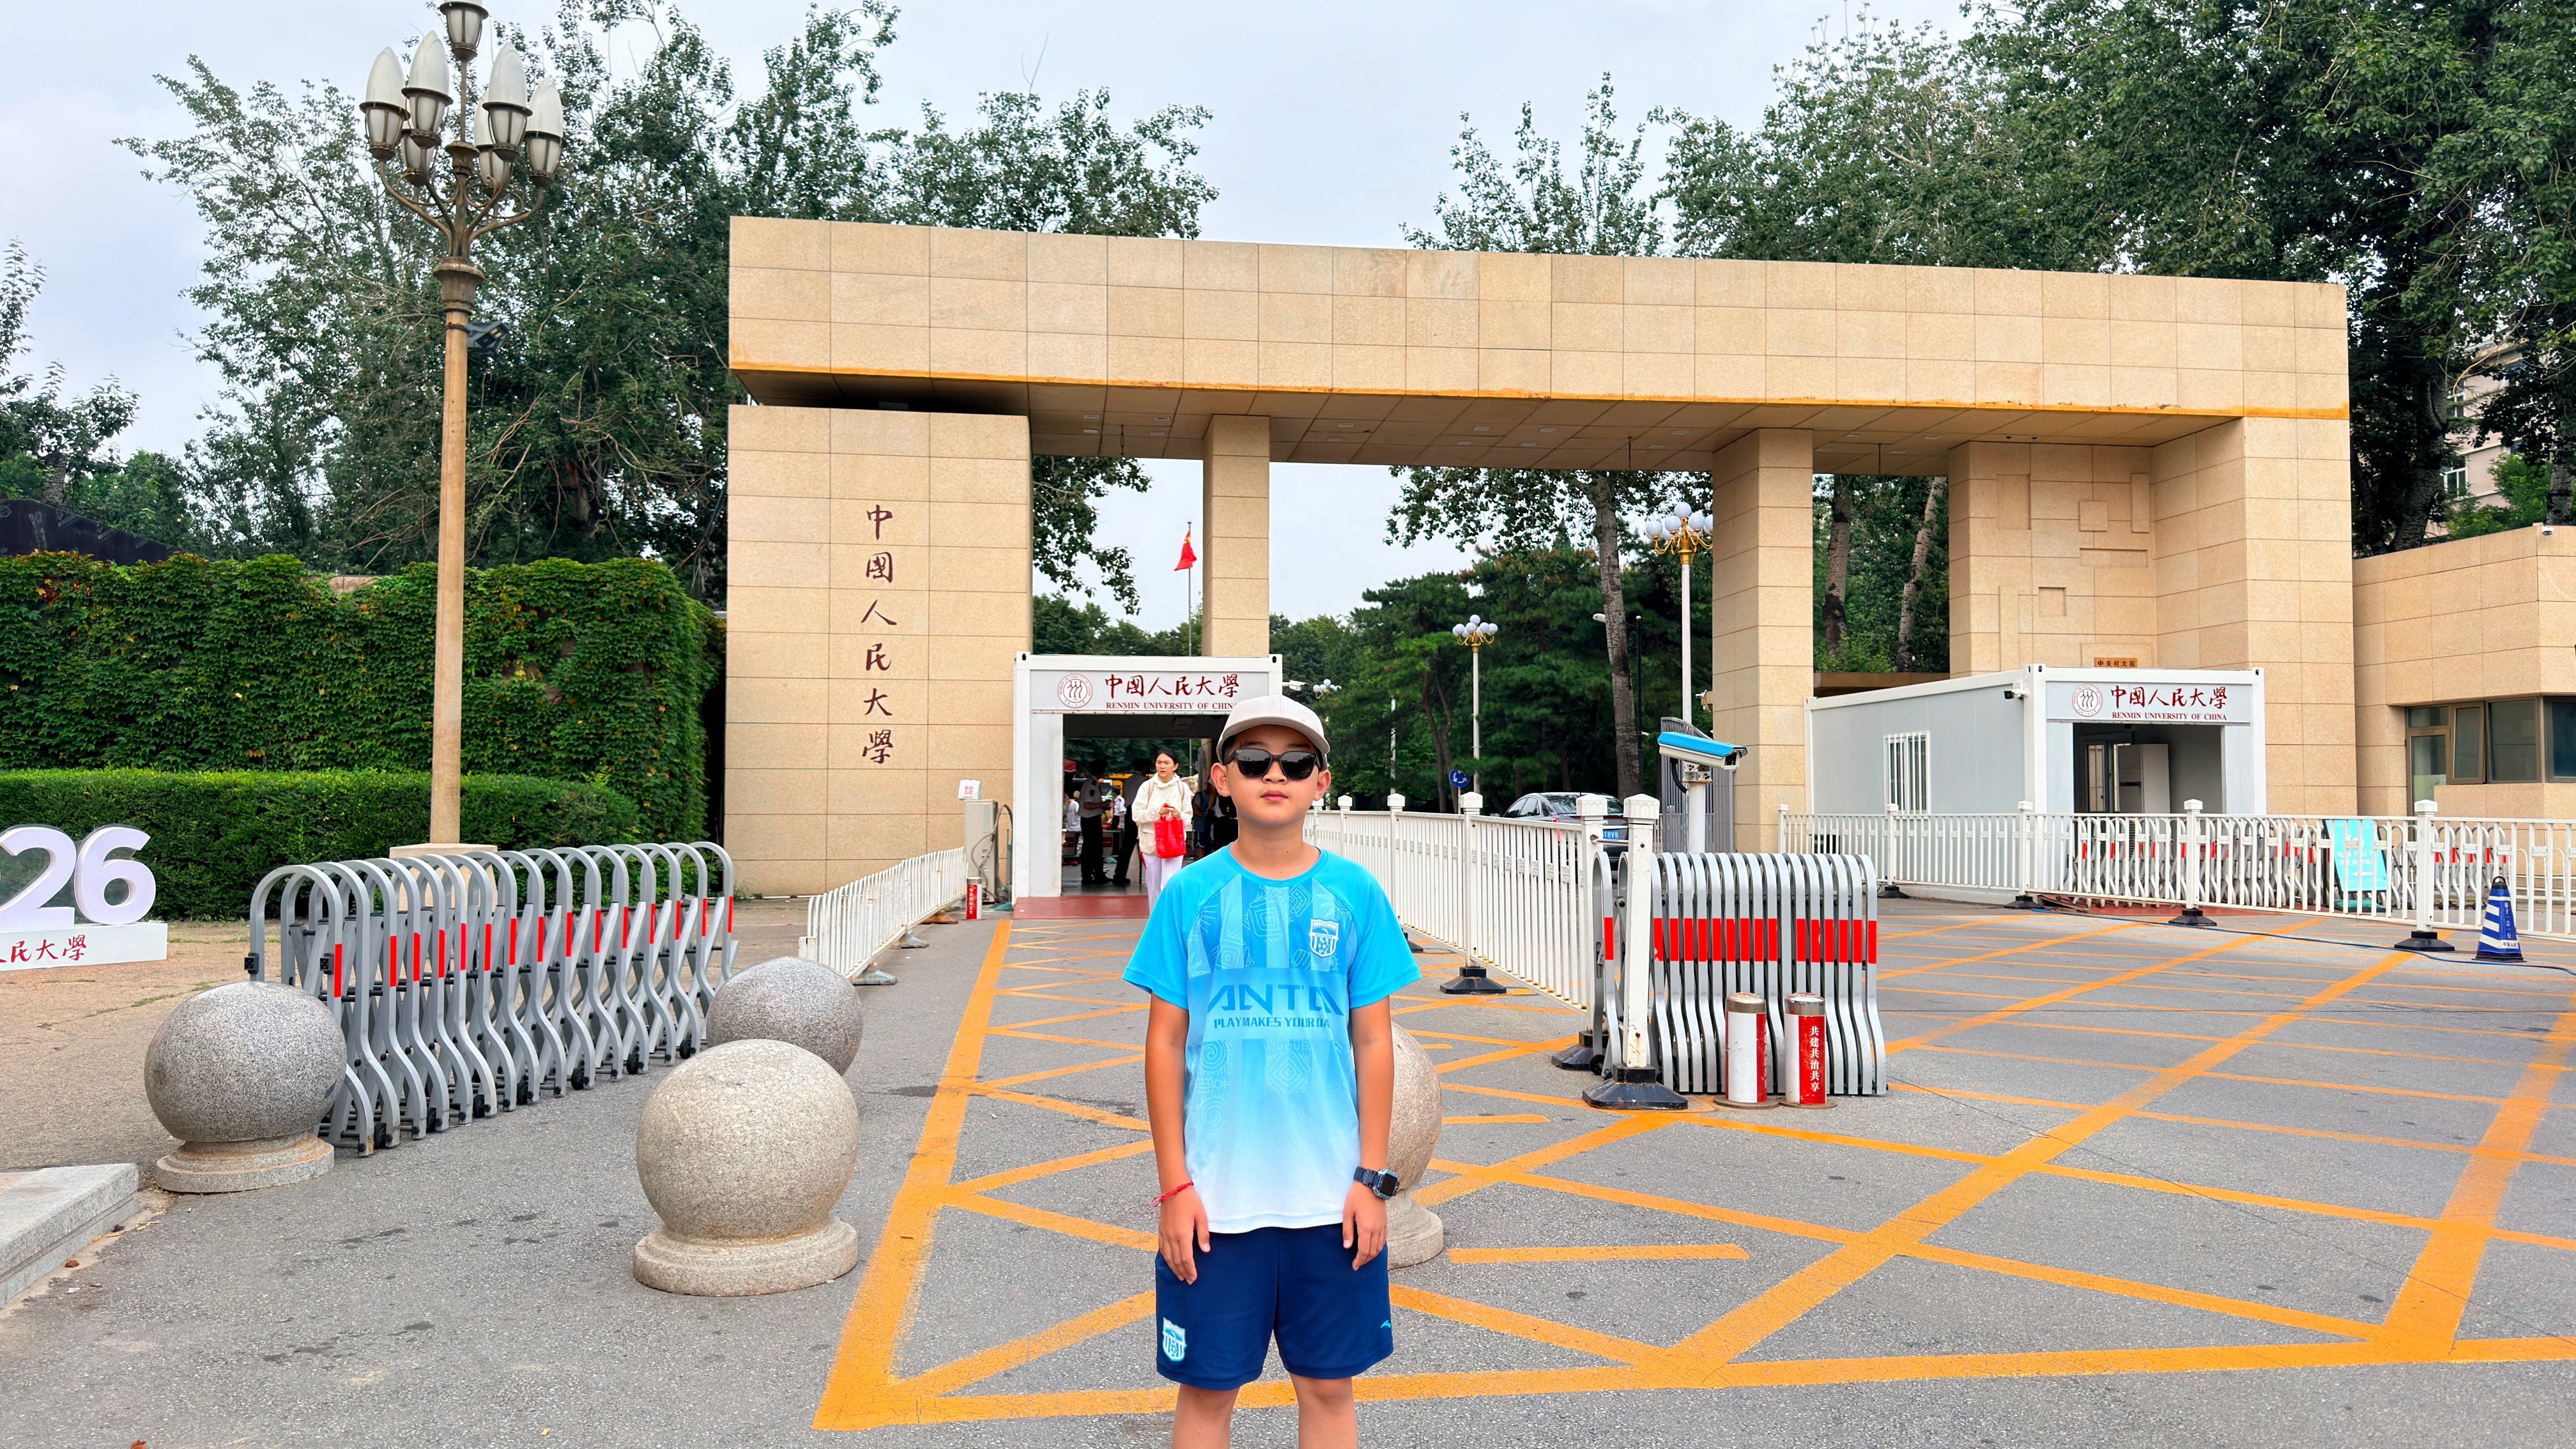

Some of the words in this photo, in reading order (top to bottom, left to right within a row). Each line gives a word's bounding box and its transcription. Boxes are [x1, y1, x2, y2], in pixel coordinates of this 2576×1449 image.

[861, 504, 898, 764] 中國人民大學
[2097, 659, 2135, 668] 中关村大街
[1105, 673, 1239, 700] 中國人民大學
[2110, 684, 2228, 709] 中國人民大學
[1208, 984, 1344, 1016] ANTA
[1284, 1016, 1315, 1027] YOUR
[1809, 1025, 1820, 1092] 共建共治共享
